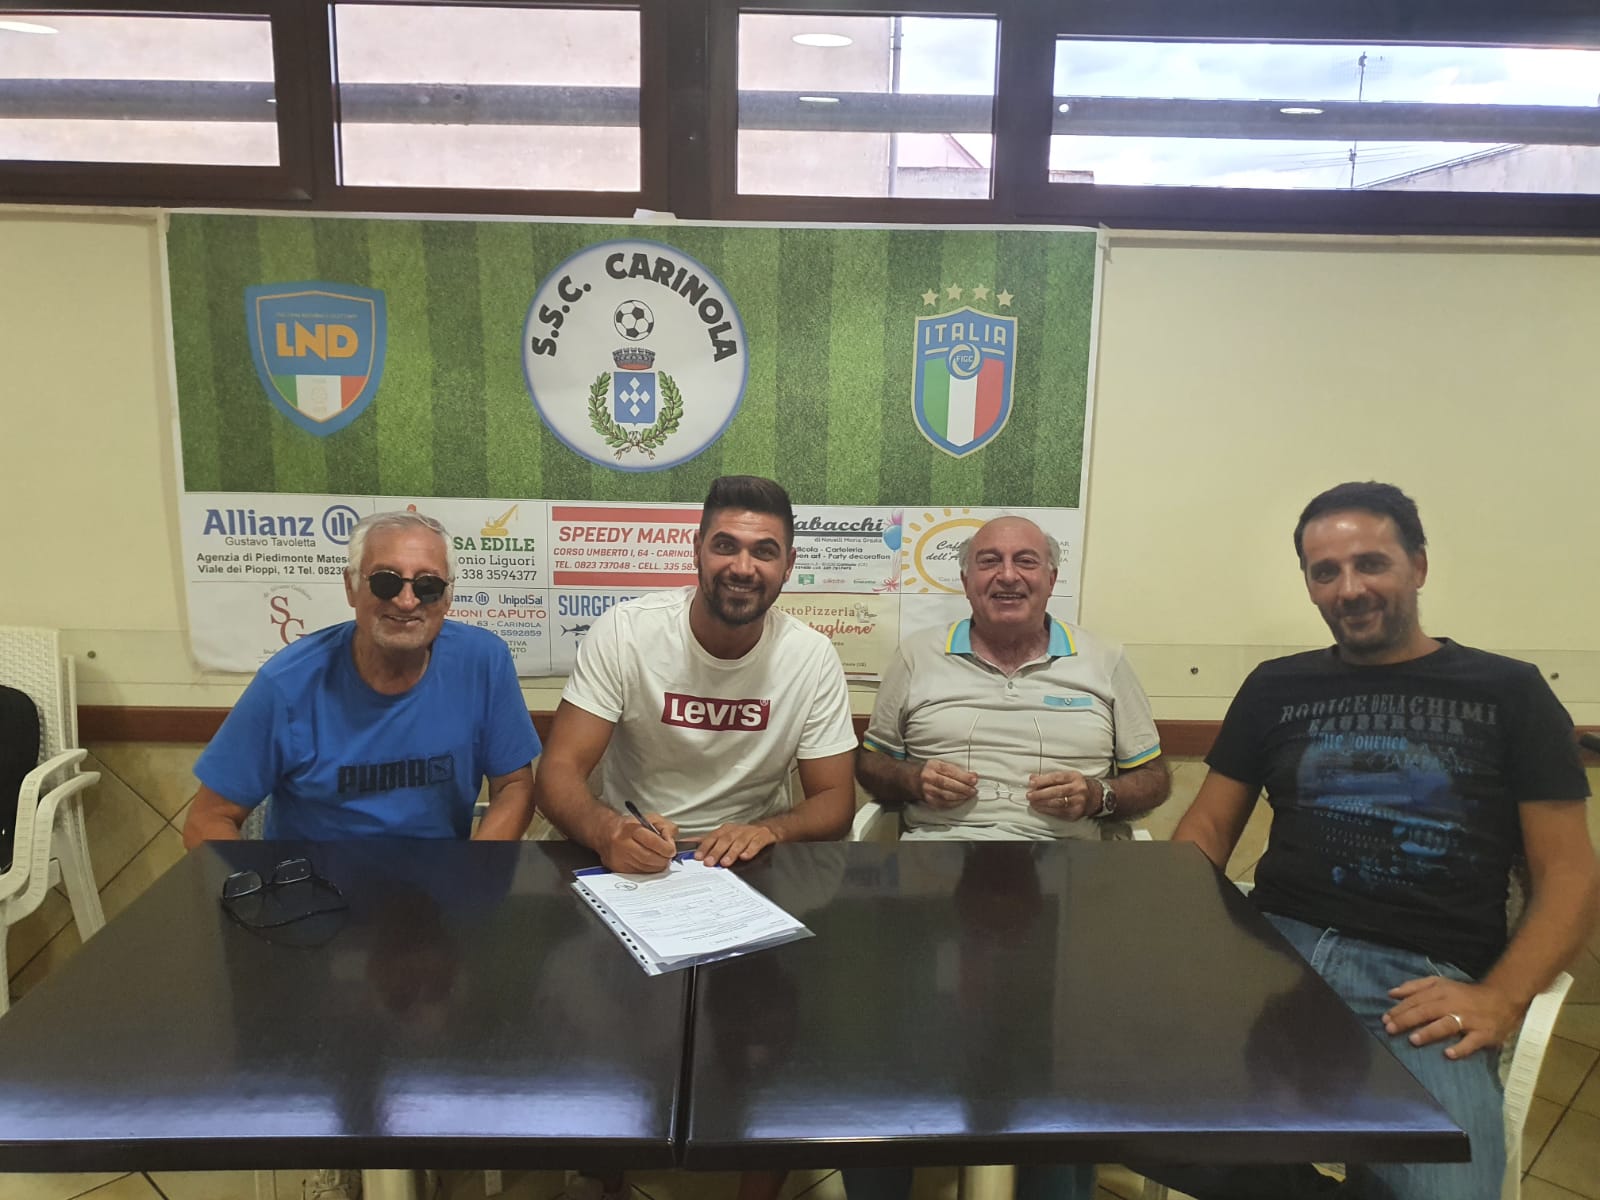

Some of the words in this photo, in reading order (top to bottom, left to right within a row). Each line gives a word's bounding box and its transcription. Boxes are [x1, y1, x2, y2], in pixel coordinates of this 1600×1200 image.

[532, 275, 591, 357] S.S.C.
[605, 252, 738, 362] CARINOLA
[925, 322, 1007, 346] ITALIA
[275, 321, 359, 362] LND
[955, 355, 973, 363] FIGC
[203, 509, 315, 536] Allianz
[559, 526, 633, 543] SPEEDY
[637, 528, 697, 544] MARK
[225, 537, 268, 547] Gustavo
[271, 538, 317, 548] Tavoletta
[453, 537, 477, 550] SA
[480, 537, 535, 552] EDILE
[196, 553, 241, 564] Agenzia
[243, 553, 253, 563] di
[256, 553, 314, 563] Piedimonte
[317, 554, 350, 564] Mates
[553, 548, 584, 556] CORSO
[587, 548, 628, 557] UMBERTO
[637, 549, 649, 557] 64
[656, 549, 695, 558] CARINOL
[458, 555, 486, 565] onio
[489, 555, 535, 568] Liguori
[555, 560, 572, 569] TEL.
[574, 561, 596, 569] 0823
[599, 562, 630, 570] 737048
[664, 562, 679, 571] 335
[198, 565, 224, 574] Viale
[226, 565, 242, 574] dei
[245, 565, 280, 576] Pioppi,
[284, 566, 295, 575] 12
[298, 566, 315, 575] Tel.
[462, 569, 483, 580] 338
[486, 570, 537, 581] 3594377
[453, 595, 473, 603] anz
[498, 594, 543, 608] UnipolSai
[487, 609, 547, 619] CAPUTO
[338, 759, 426, 794] PUMA
